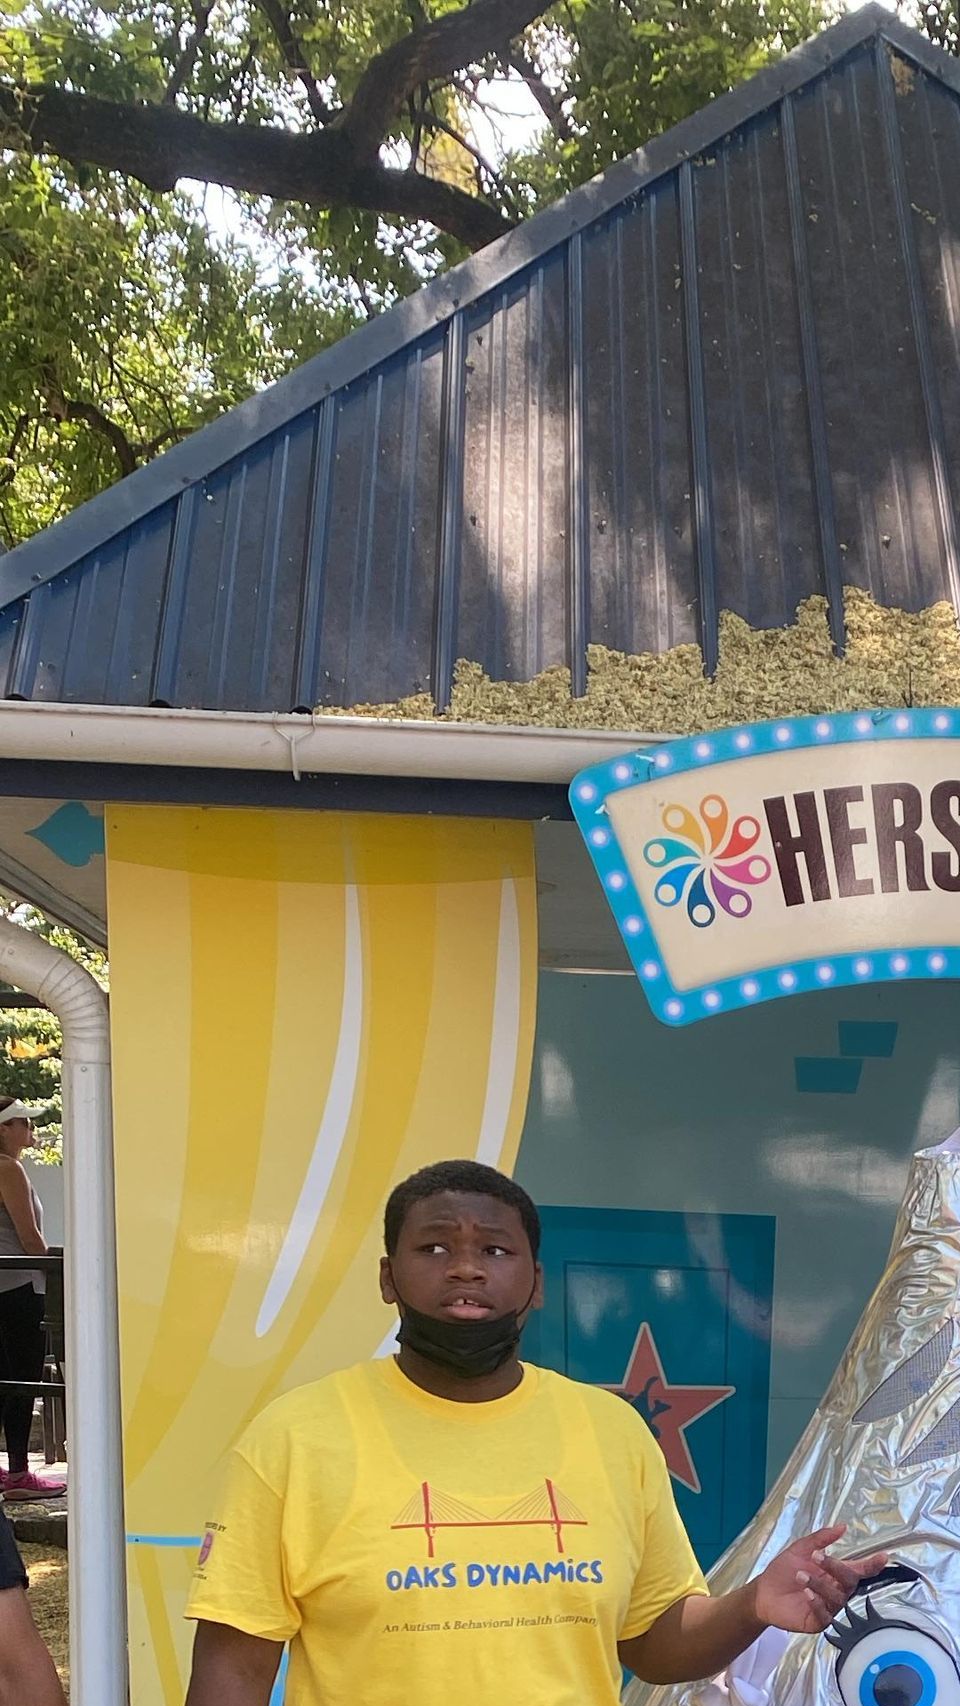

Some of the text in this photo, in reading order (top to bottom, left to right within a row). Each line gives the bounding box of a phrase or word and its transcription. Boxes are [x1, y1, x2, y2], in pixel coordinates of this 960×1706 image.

[386, 1563, 457, 1591] OAKS
[383, 1614, 598, 1633] An Autism & Behavioral Health Compan
